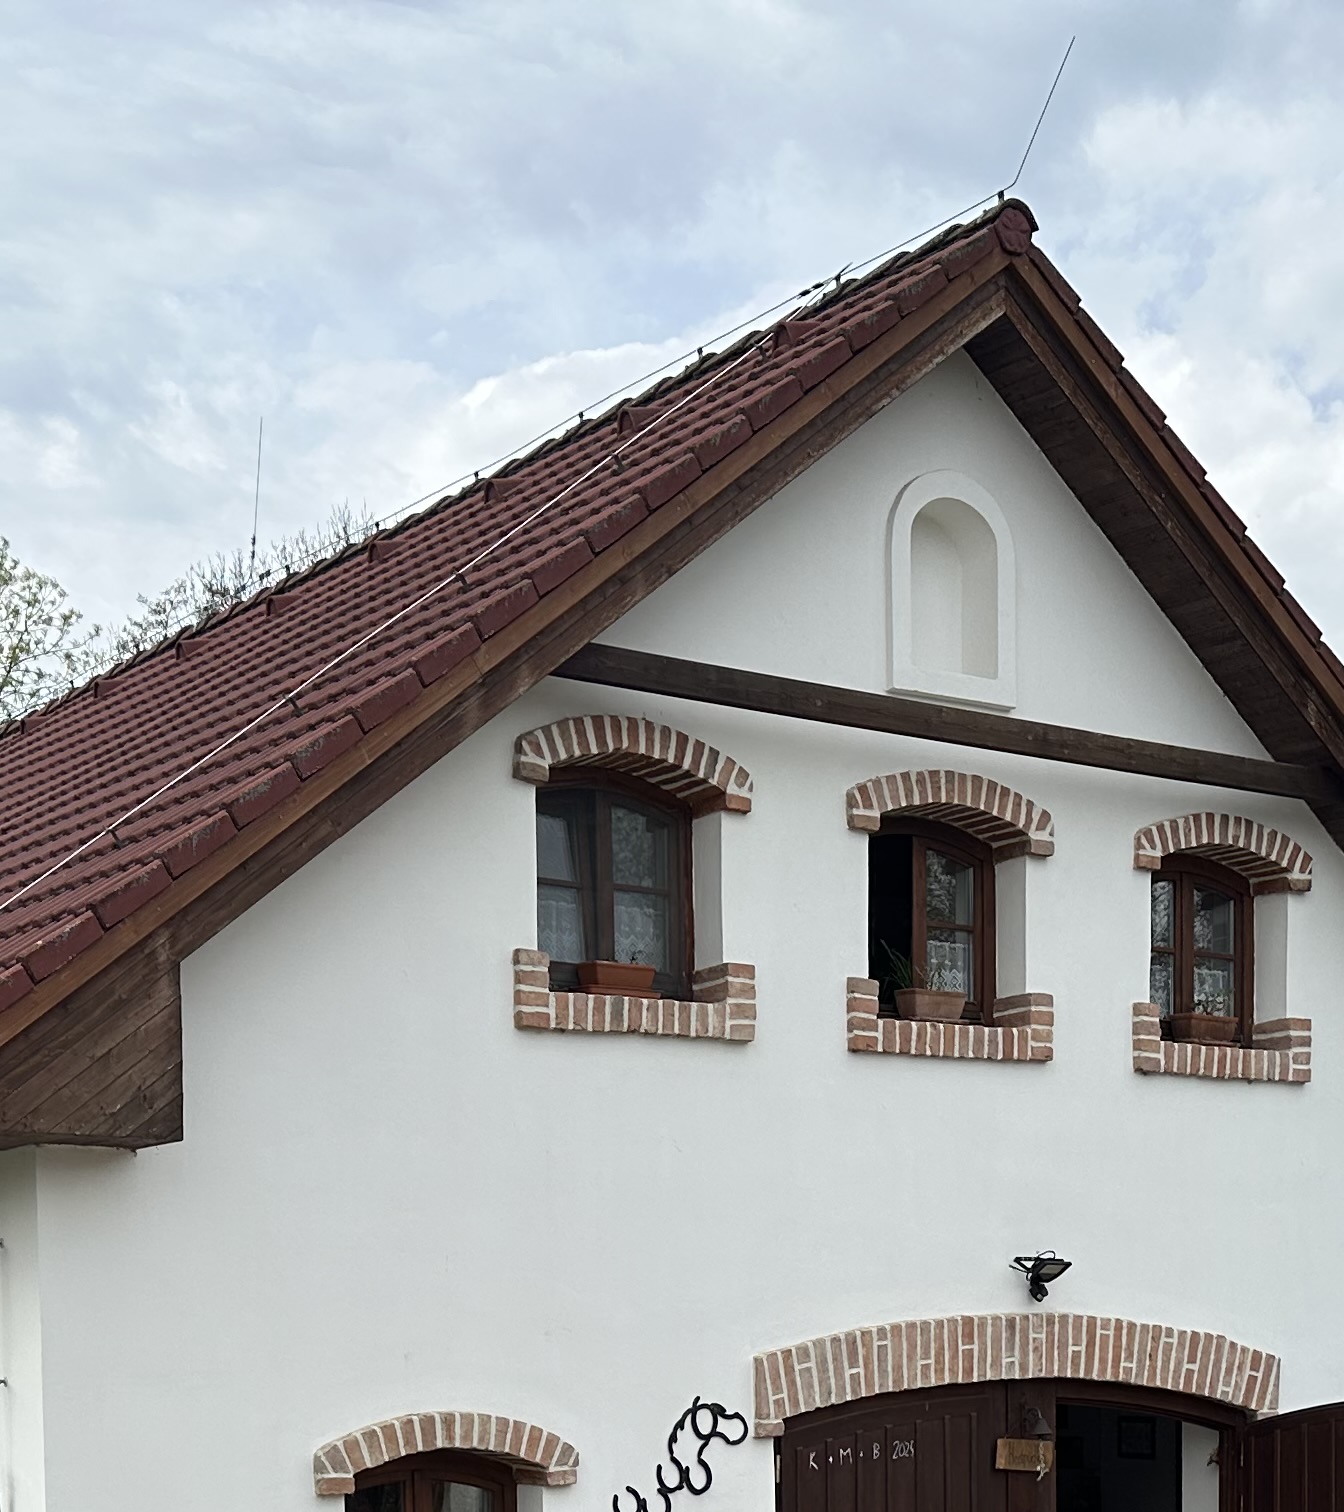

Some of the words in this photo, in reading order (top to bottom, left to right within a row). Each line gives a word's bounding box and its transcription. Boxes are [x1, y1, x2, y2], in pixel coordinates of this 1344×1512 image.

[809, 1451, 819, 1470] K
[839, 1447, 853, 1466] M
[873, 1442, 881, 1460] B
[892, 1439, 915, 1460] 2025
